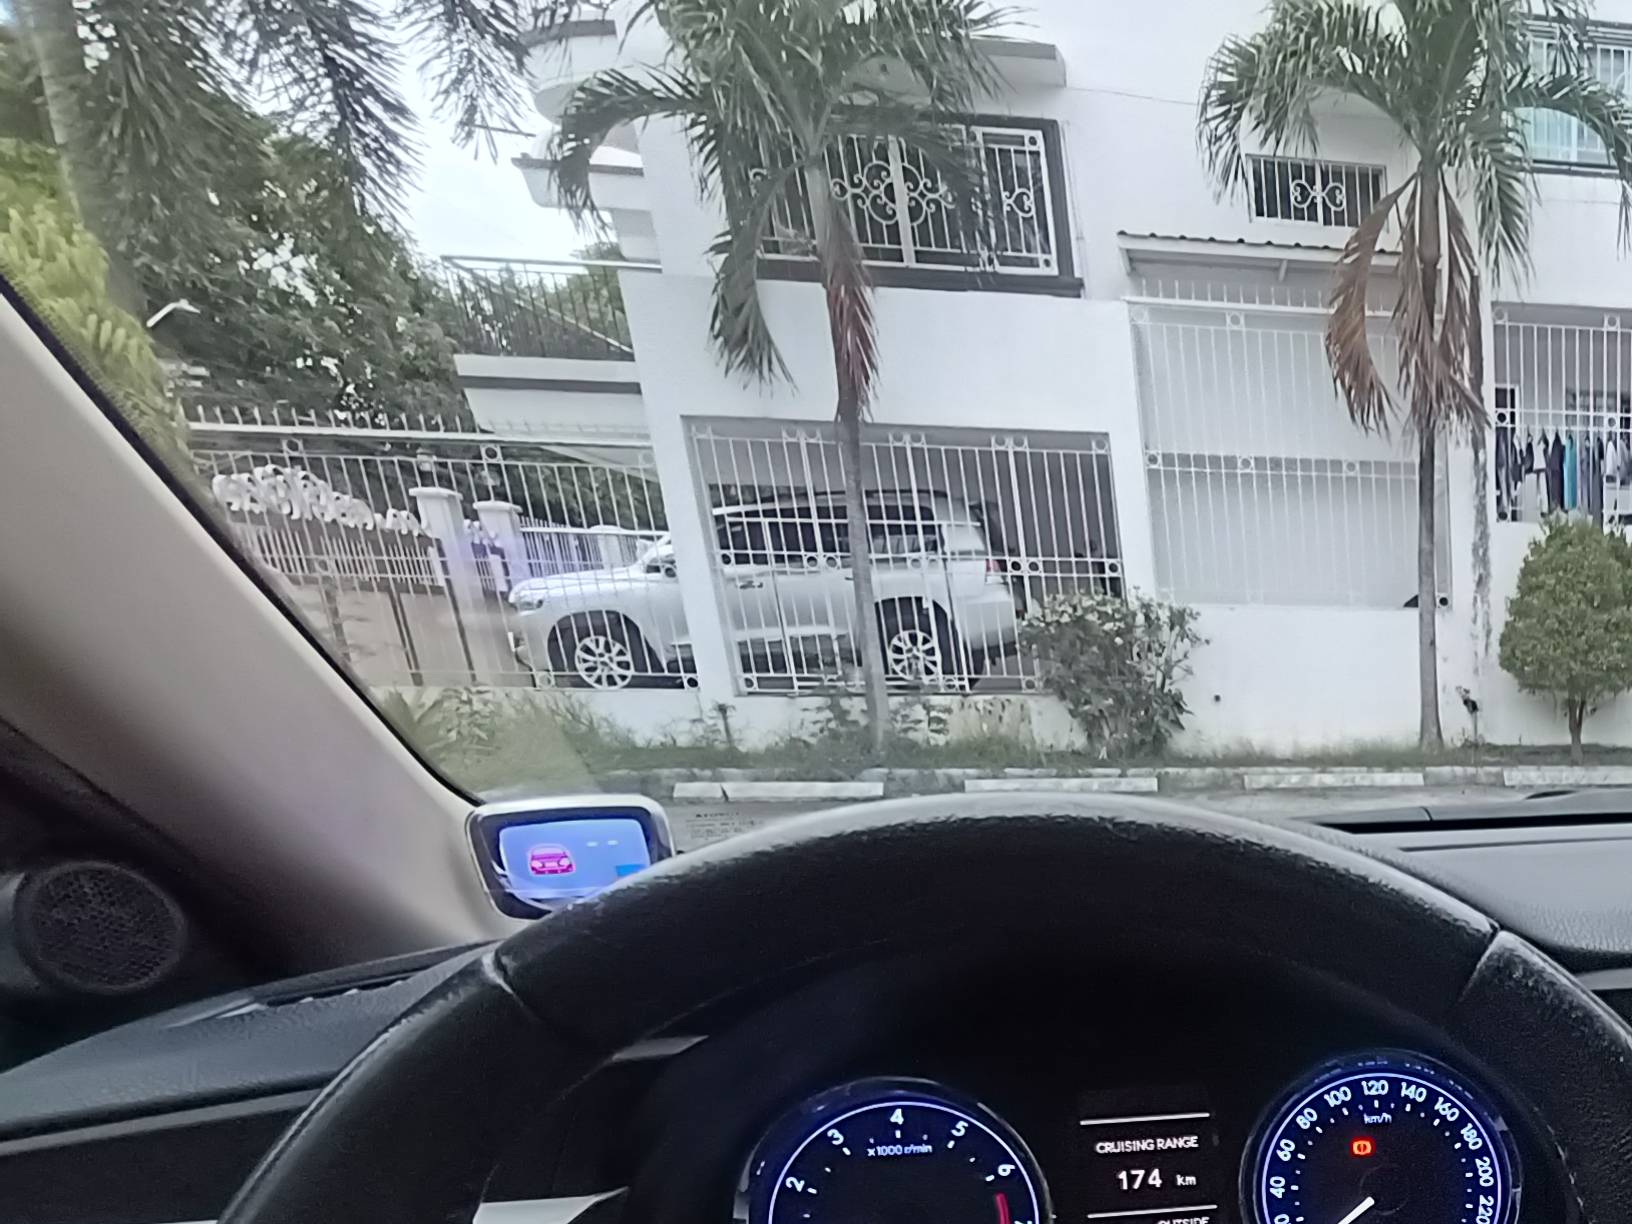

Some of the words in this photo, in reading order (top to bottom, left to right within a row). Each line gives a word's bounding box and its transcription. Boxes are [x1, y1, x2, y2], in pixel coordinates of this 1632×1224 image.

[1323, 1085, 1352, 1107] 100
[1361, 1079, 1389, 1096] 120
[1400, 1081, 1427, 1103] 140
[890, 1107, 905, 1125] 4
[1295, 1107, 1318, 1130] 80
[1363, 1112, 1393, 1124] km/h
[1433, 1096, 1460, 1122] 160
[827, 1128, 844, 1146] 3
[951, 1120, 969, 1137] 5
[1460, 1122, 1483, 1150] 180
[1095, 1139, 1155, 1155] CRUISING
[1157, 1135, 1199, 1151] RANGE
[1276, 1137, 1296, 1162] 60
[997, 1162, 1017, 1178] 6
[1117, 1168, 1163, 1191] 174
[1176, 1174, 1197, 1186] km
[1475, 1156, 1495, 1188] 200
[785, 1175, 806, 1192] 2
[1269, 1175, 1286, 1199] 40
